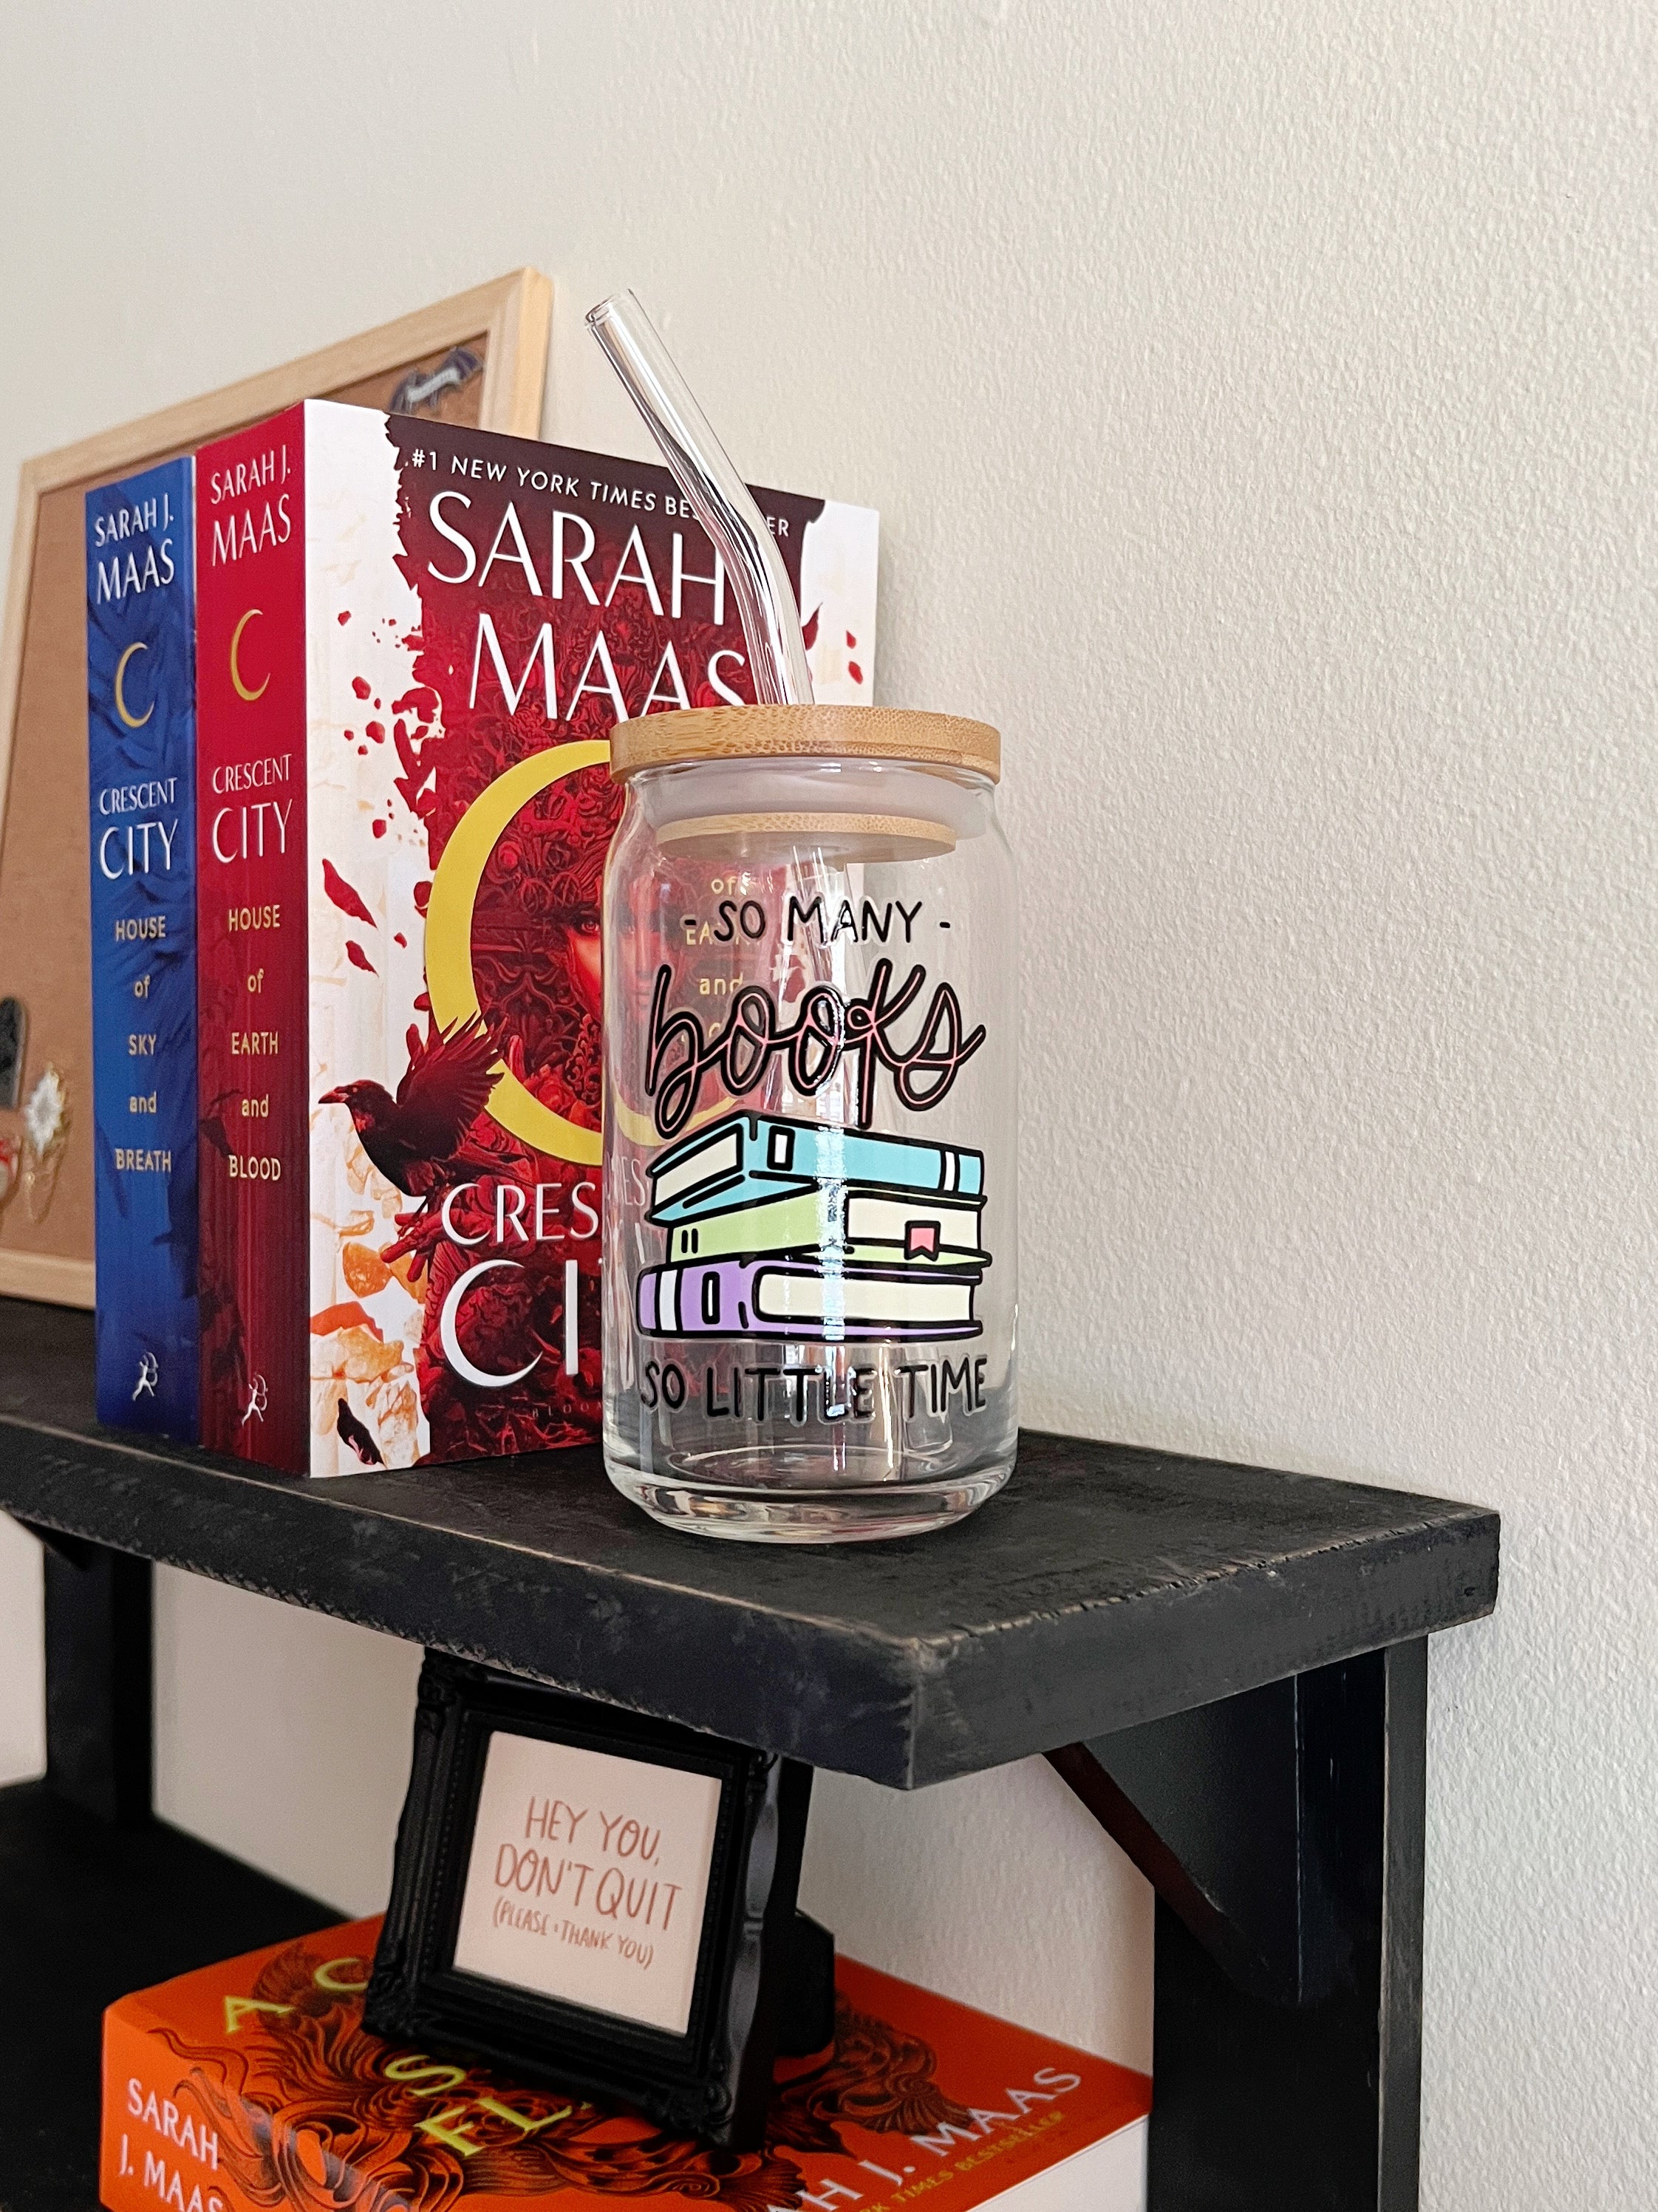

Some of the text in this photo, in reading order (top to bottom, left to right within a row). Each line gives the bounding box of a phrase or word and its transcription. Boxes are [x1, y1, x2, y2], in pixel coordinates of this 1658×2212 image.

[211, 445, 291, 504] SARAH J.
[412, 448, 655, 511] #1 NEW YORK TIMES
[95, 494, 174, 547] SARAH J.
[212, 494, 290, 567] MAAS
[97, 538, 175, 604] MAAS
[427, 491, 725, 626] SARAH
[469, 612, 746, 723] MAAS
[100, 777, 177, 815] CRESCENT
[212, 754, 292, 794] CRESCENT
[100, 819, 178, 879] CITY
[212, 799, 293, 864] CITY
[115, 915, 166, 941] HOUSE
[229, 904, 280, 932] HOUSE
[787, 895, 922, 943] MANY
[134, 974, 150, 997] of
[248, 969, 264, 993] of
[129, 1034, 156, 1056] SKY
[231, 1031, 279, 1054] EARTH
[129, 1091, 157, 1113] and
[242, 1094, 269, 1117] and
[115, 1148, 171, 1172] BREATH
[228, 1154, 281, 1181] BLOOD
[441, 1182, 599, 1246] CRES
[641, 1358, 988, 1421] SO LITTLE TIME
[525, 1796, 589, 1843] HEY
[494, 1843, 682, 1931] DON'T QUIT
[562, 1919, 614, 1950] THANK
[128, 2078, 218, 2171] SARAH
[910, 2067, 1081, 2157] MAAS
